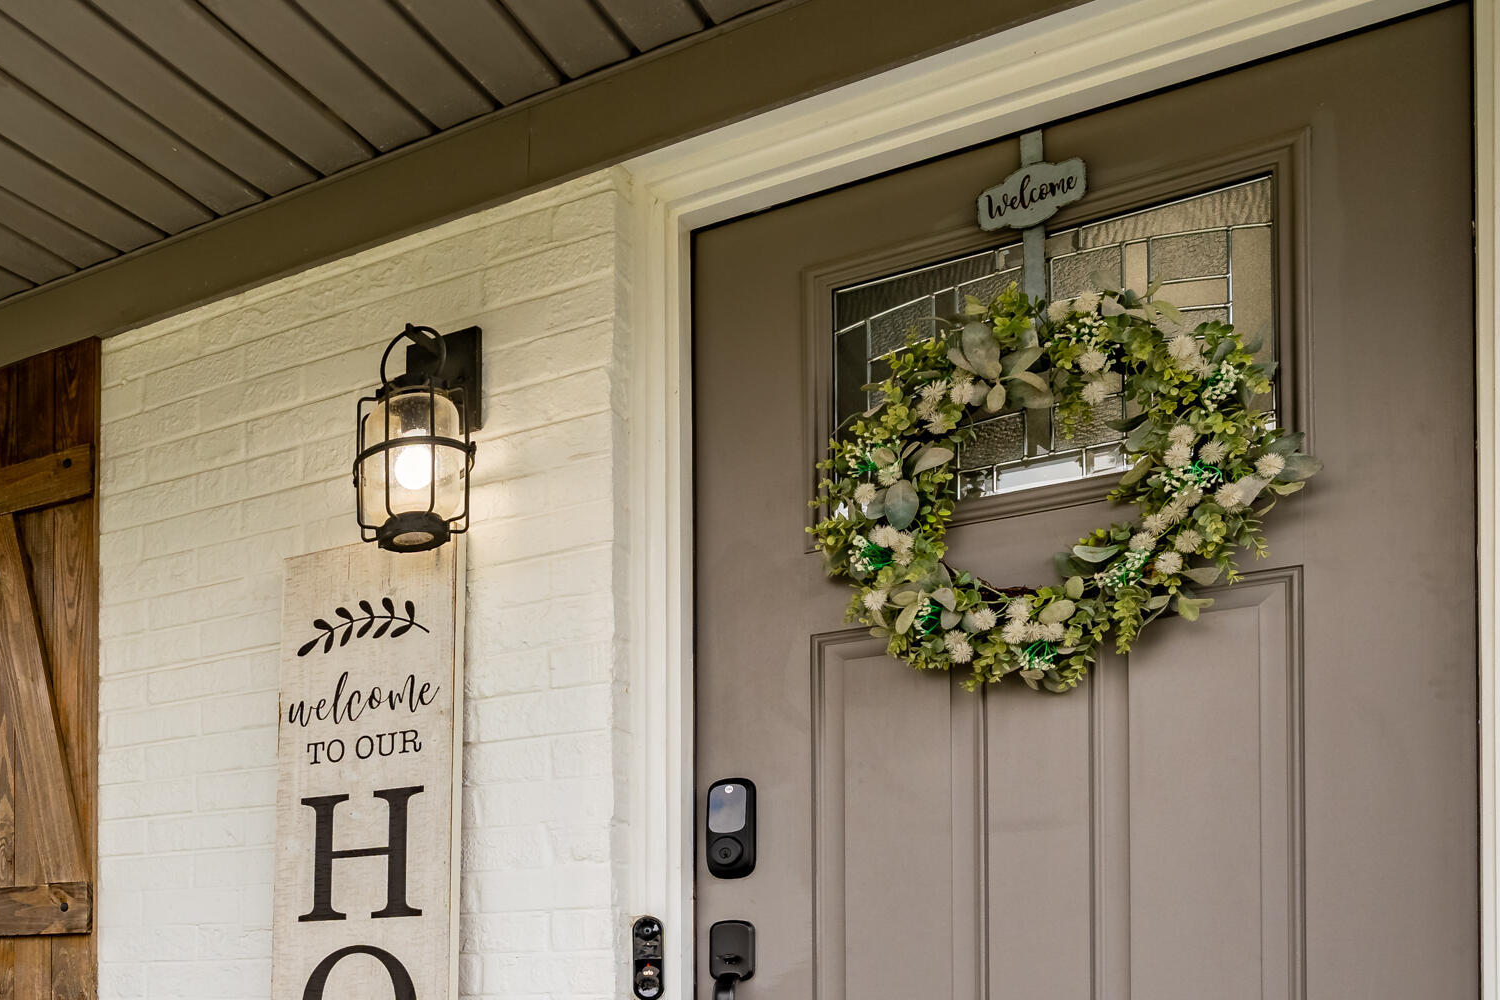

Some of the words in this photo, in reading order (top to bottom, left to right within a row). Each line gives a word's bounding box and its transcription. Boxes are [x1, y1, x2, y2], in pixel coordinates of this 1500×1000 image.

[985, 174, 1078, 219] Welcome
[288, 671, 440, 728] welcome
[306, 738, 346, 765] TO
[355, 729, 423, 760] OUR
